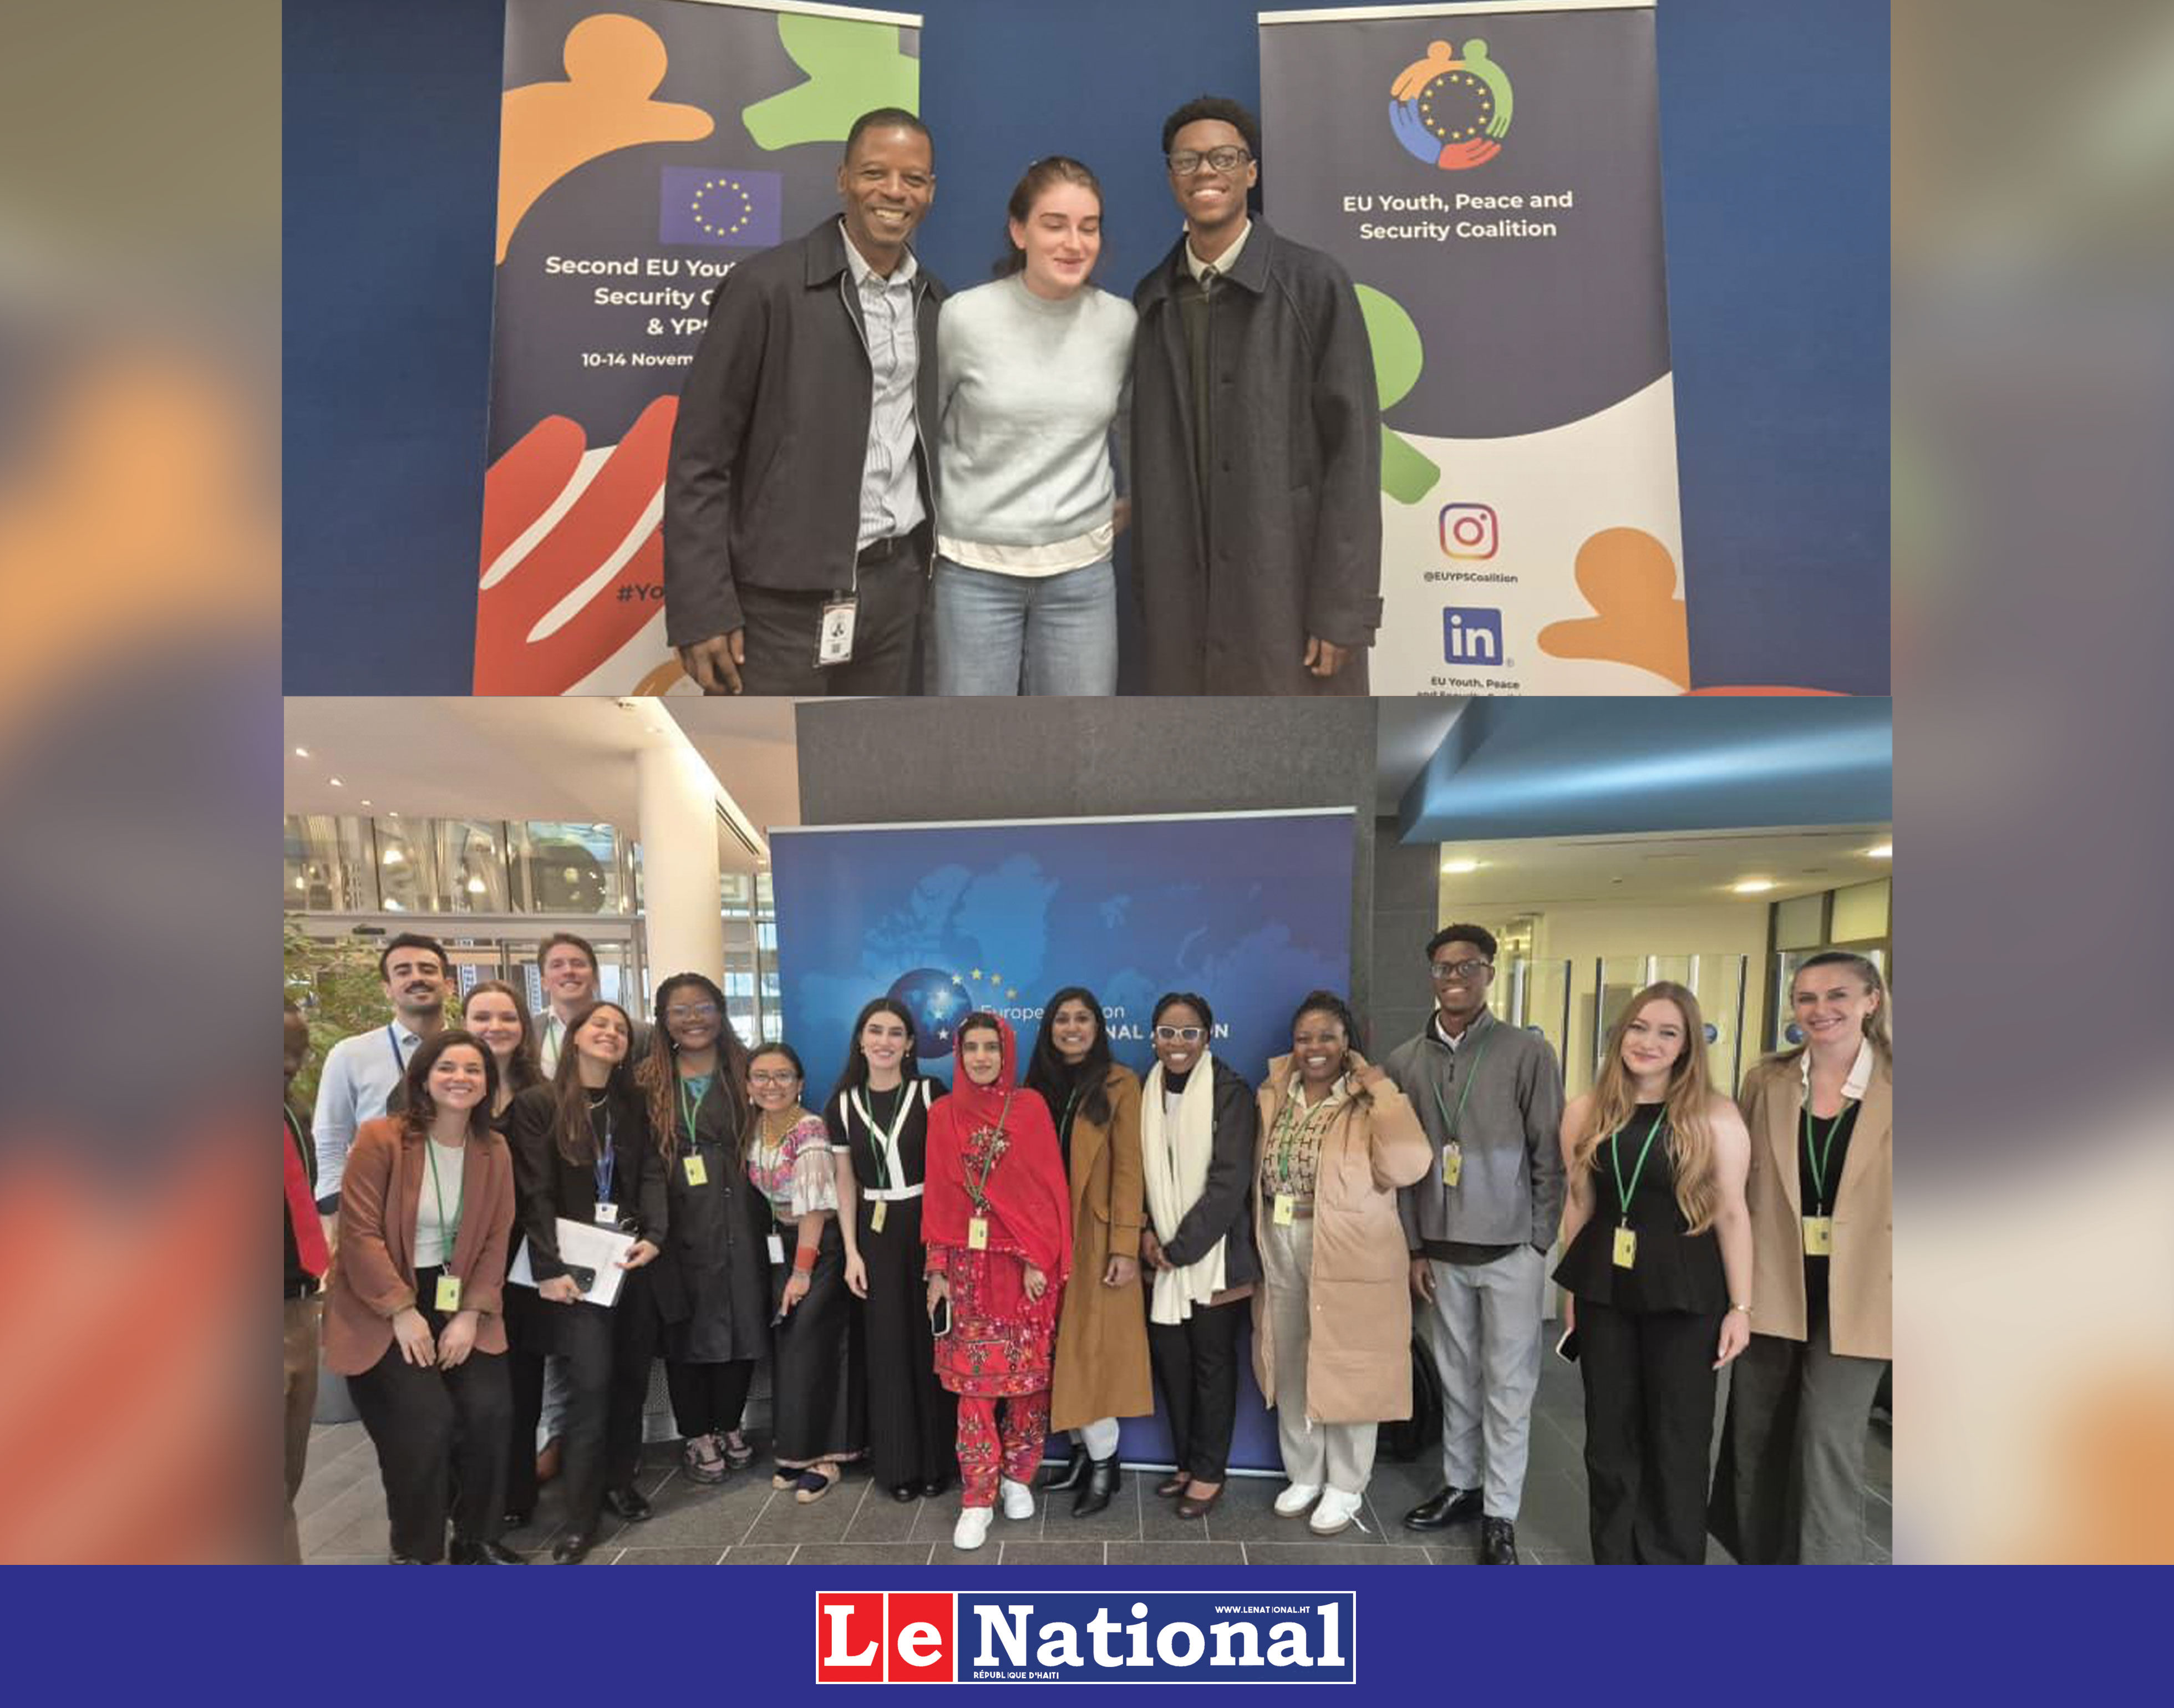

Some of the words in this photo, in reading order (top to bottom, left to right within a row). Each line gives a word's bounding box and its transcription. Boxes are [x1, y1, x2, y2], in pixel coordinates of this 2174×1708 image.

[1343, 196, 1372, 212] EU
[1379, 194, 1449, 212] Youth,
[1455, 193, 1523, 210] Peace
[1530, 191, 1573, 209] and
[1360, 221, 1450, 241] Security
[1456, 219, 1557, 238] Coalition
[545, 256, 638, 274] Second
[646, 259, 679, 276] EU
[594, 287, 695, 309] Security
[647, 318, 664, 335] &
[581, 353, 627, 367] 10-14
[1424, 571, 1518, 583] @EUYPSCoalition
[1451, 614, 1495, 657] in
[1431, 676, 1446, 685] EU
[1486, 679, 1520, 689] Peace
